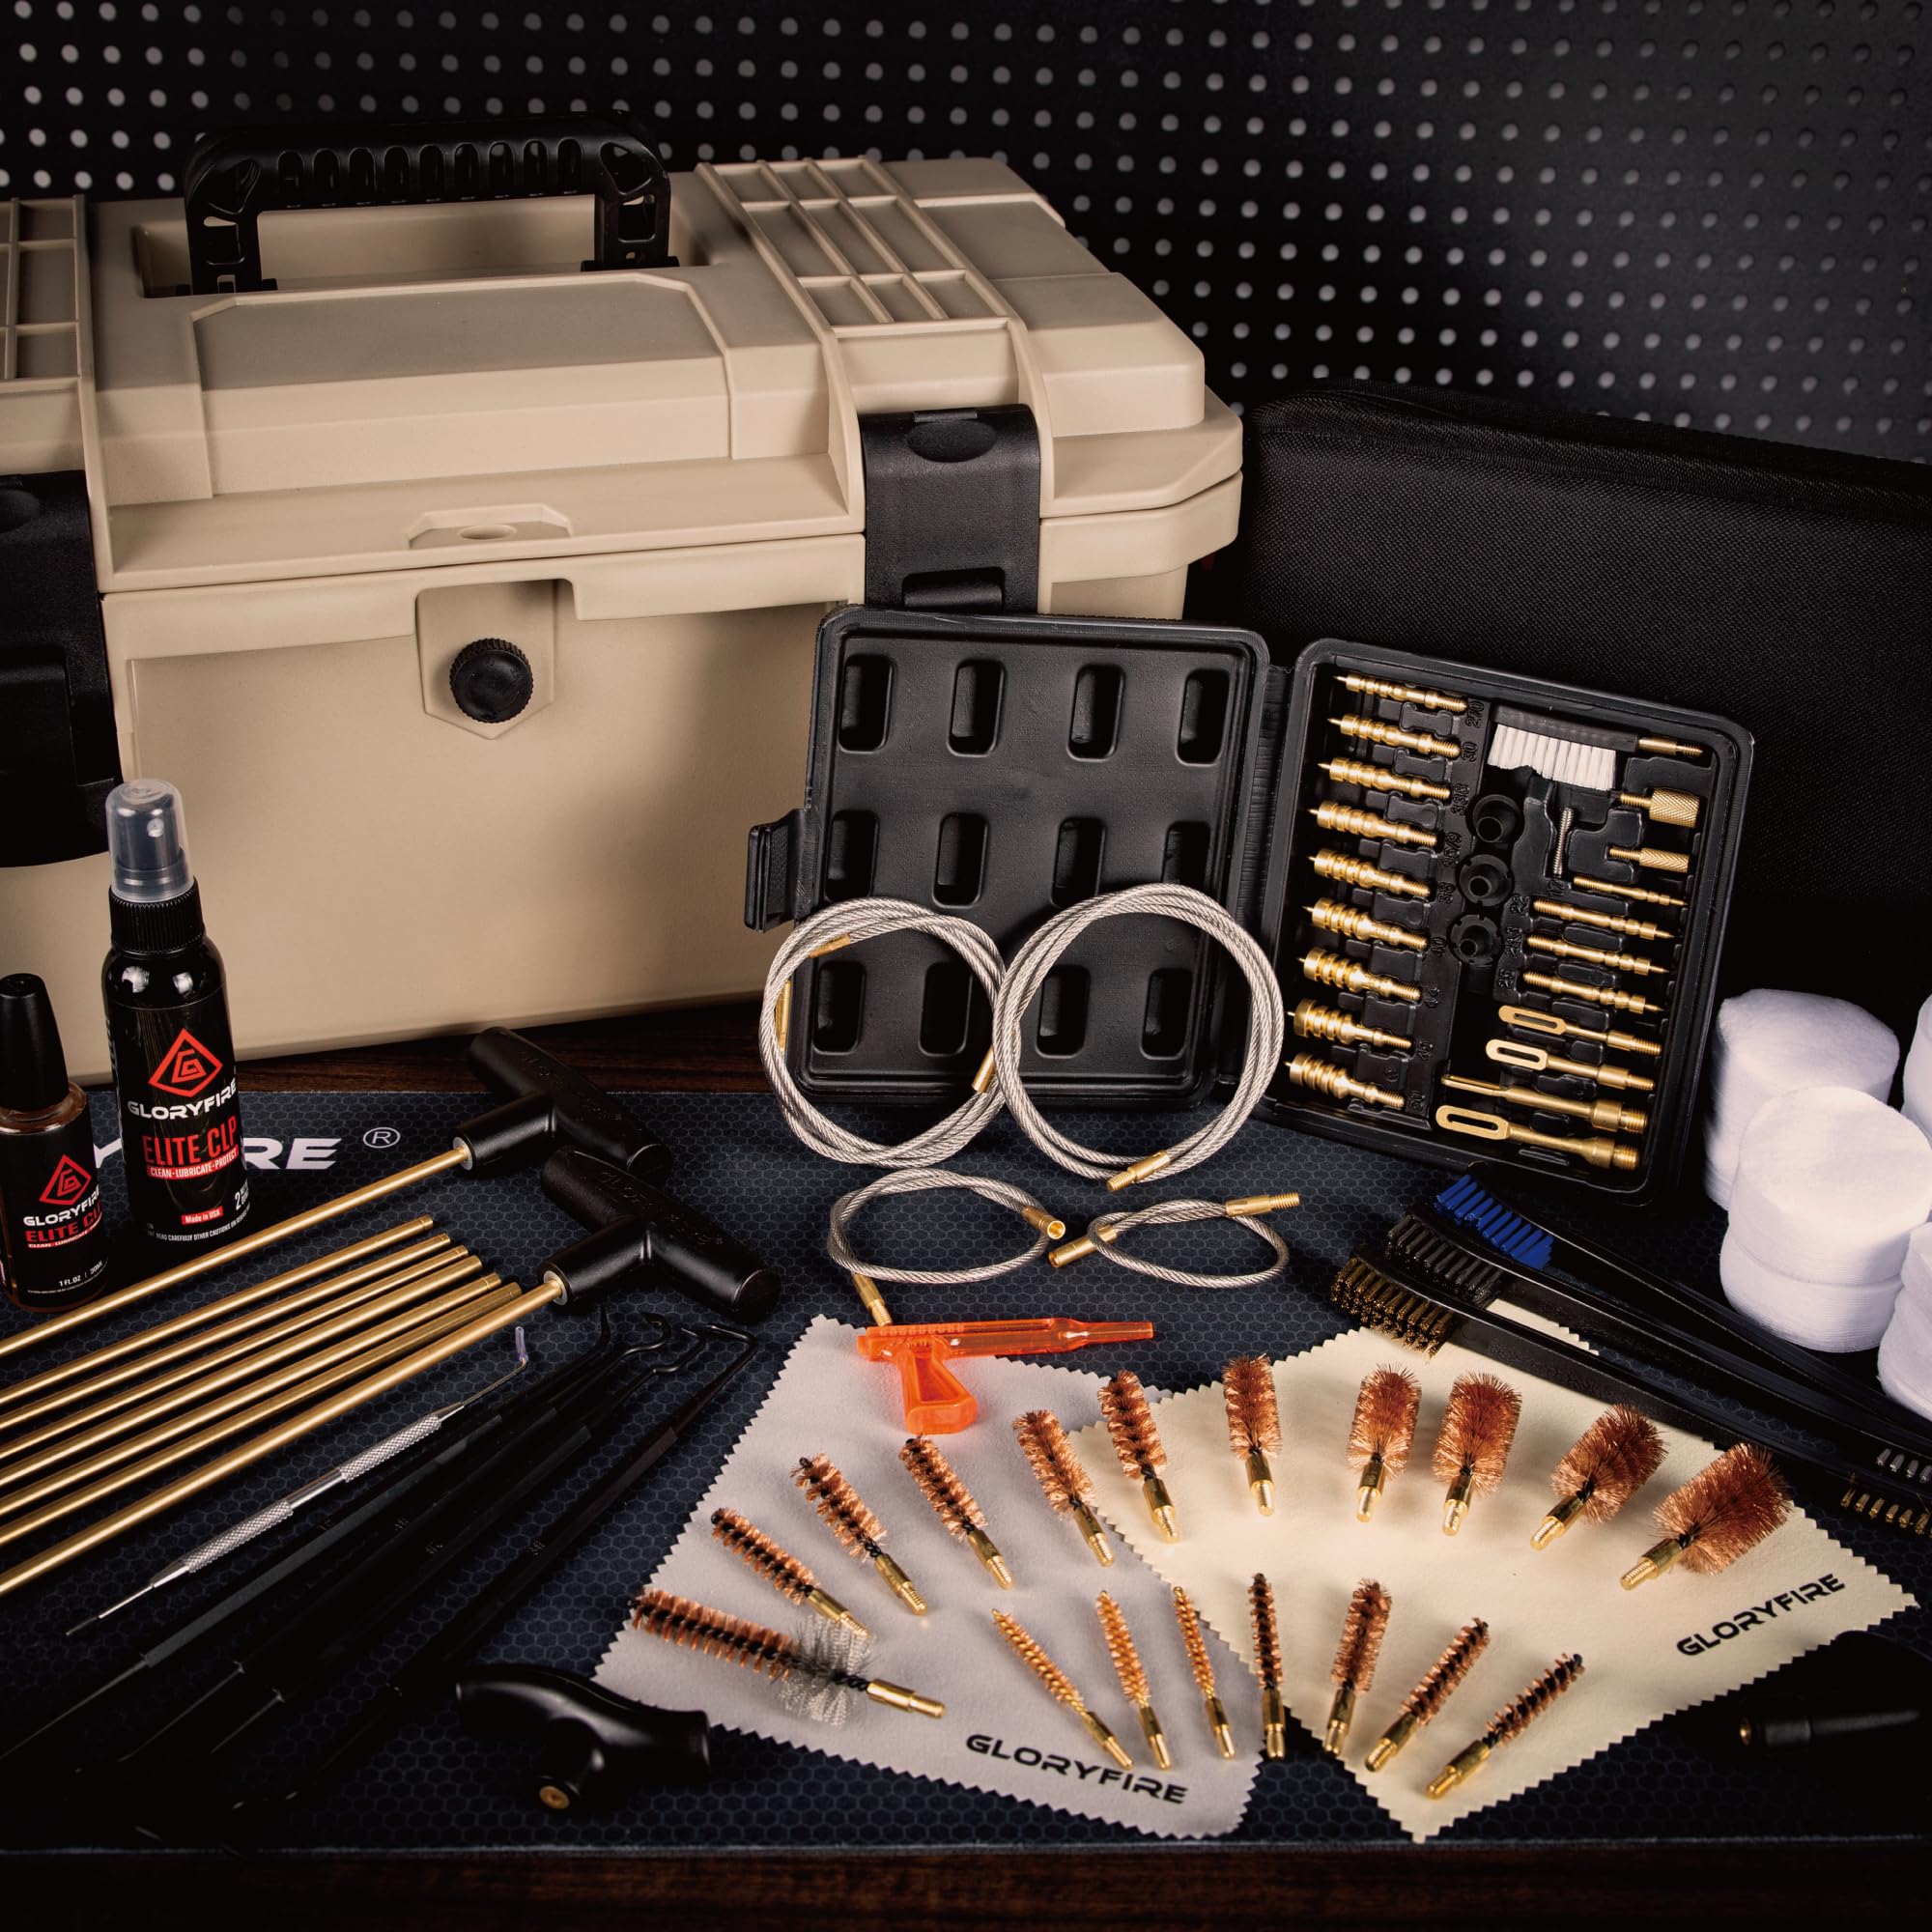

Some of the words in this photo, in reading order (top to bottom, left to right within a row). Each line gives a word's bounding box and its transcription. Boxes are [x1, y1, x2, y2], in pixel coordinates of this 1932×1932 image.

[1464, 699, 1485, 729] 270
[1460, 741, 1478, 763] 30
[128, 1076, 237, 1120] GLORYFIRE
[141, 1134, 201, 1166] ELITE
[207, 1115, 238, 1158] CLP
[26, 1221, 77, 1242] ELITE
[185, 1214, 202, 1224] Made
[203, 1211, 209, 1221] in
[210, 1208, 220, 1219] USA
[1677, 1574, 1845, 1656] GLORYFIRE
[966, 1734, 1187, 1804] GLORYFIRE
